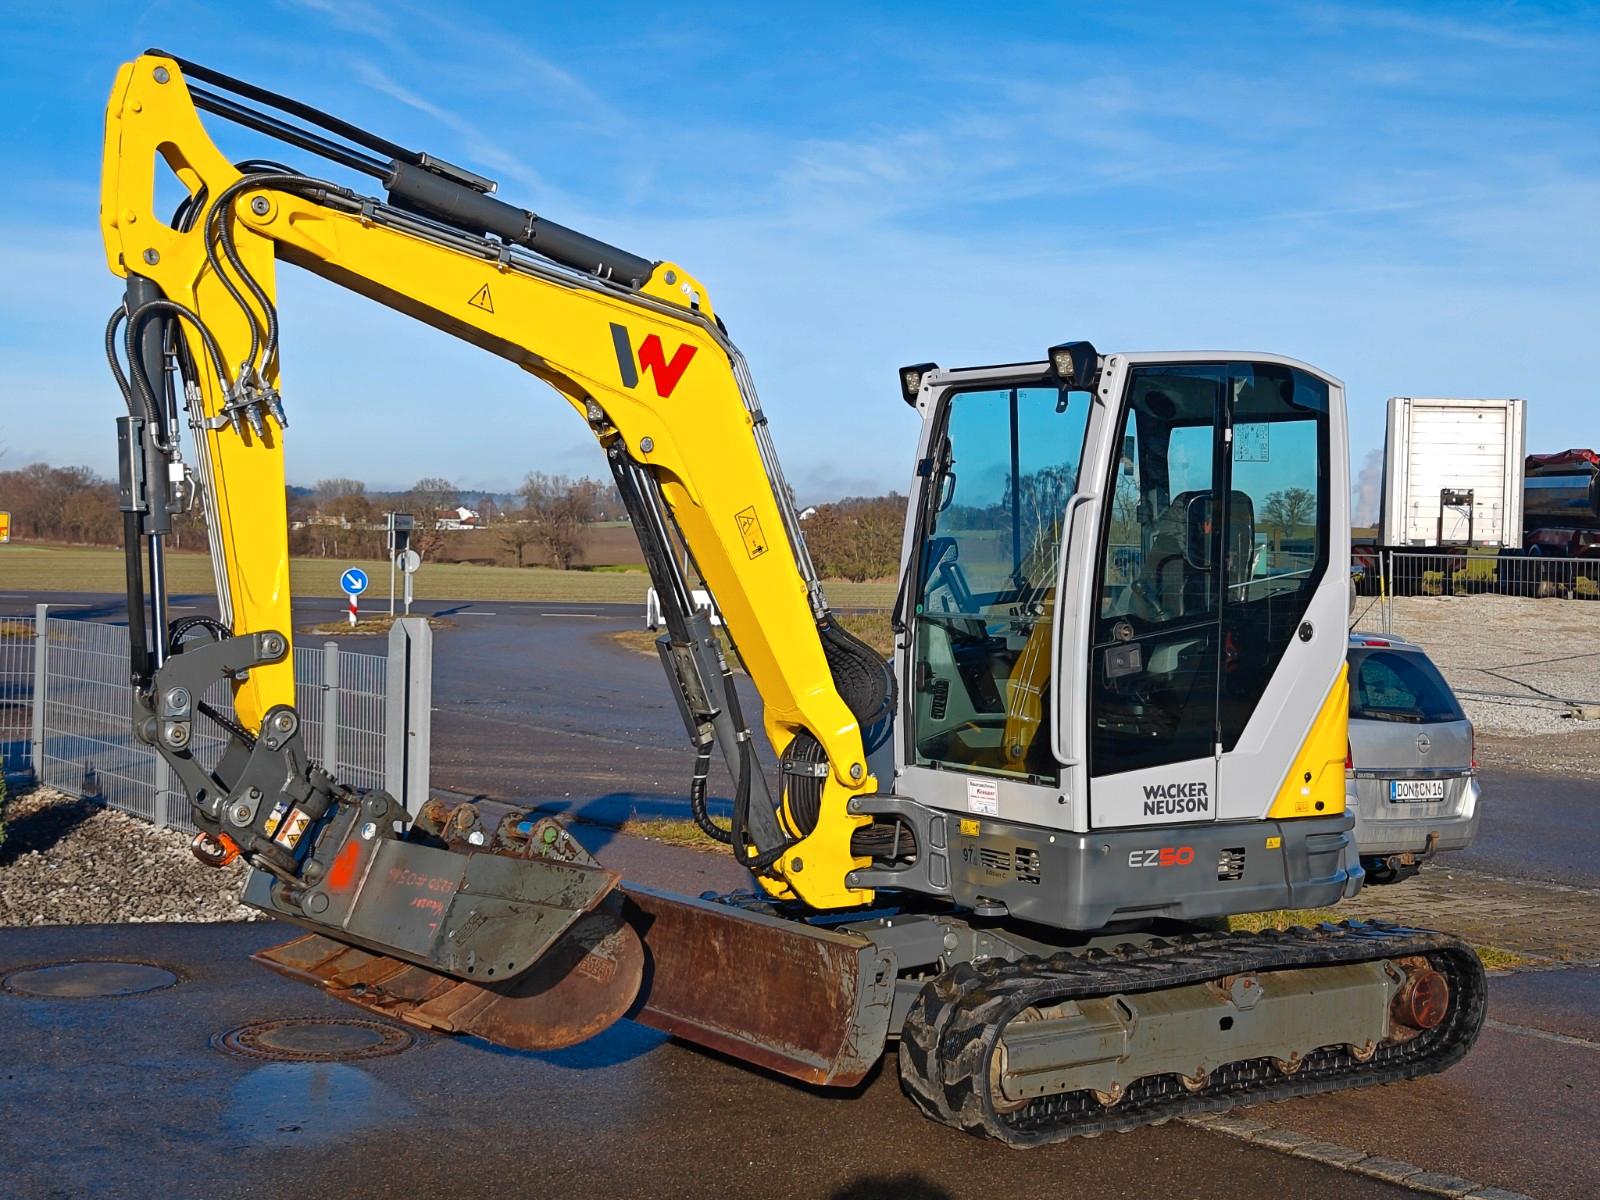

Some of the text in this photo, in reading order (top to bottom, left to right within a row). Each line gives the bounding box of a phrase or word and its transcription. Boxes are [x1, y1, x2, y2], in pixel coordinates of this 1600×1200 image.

[1143, 782, 1208, 800] WACKER
[1397, 782, 1443, 797] DON CN 16
[1143, 798, 1208, 816] NEUSON
[963, 847, 973, 864] 97
[1128, 846, 1195, 868] EZ50
